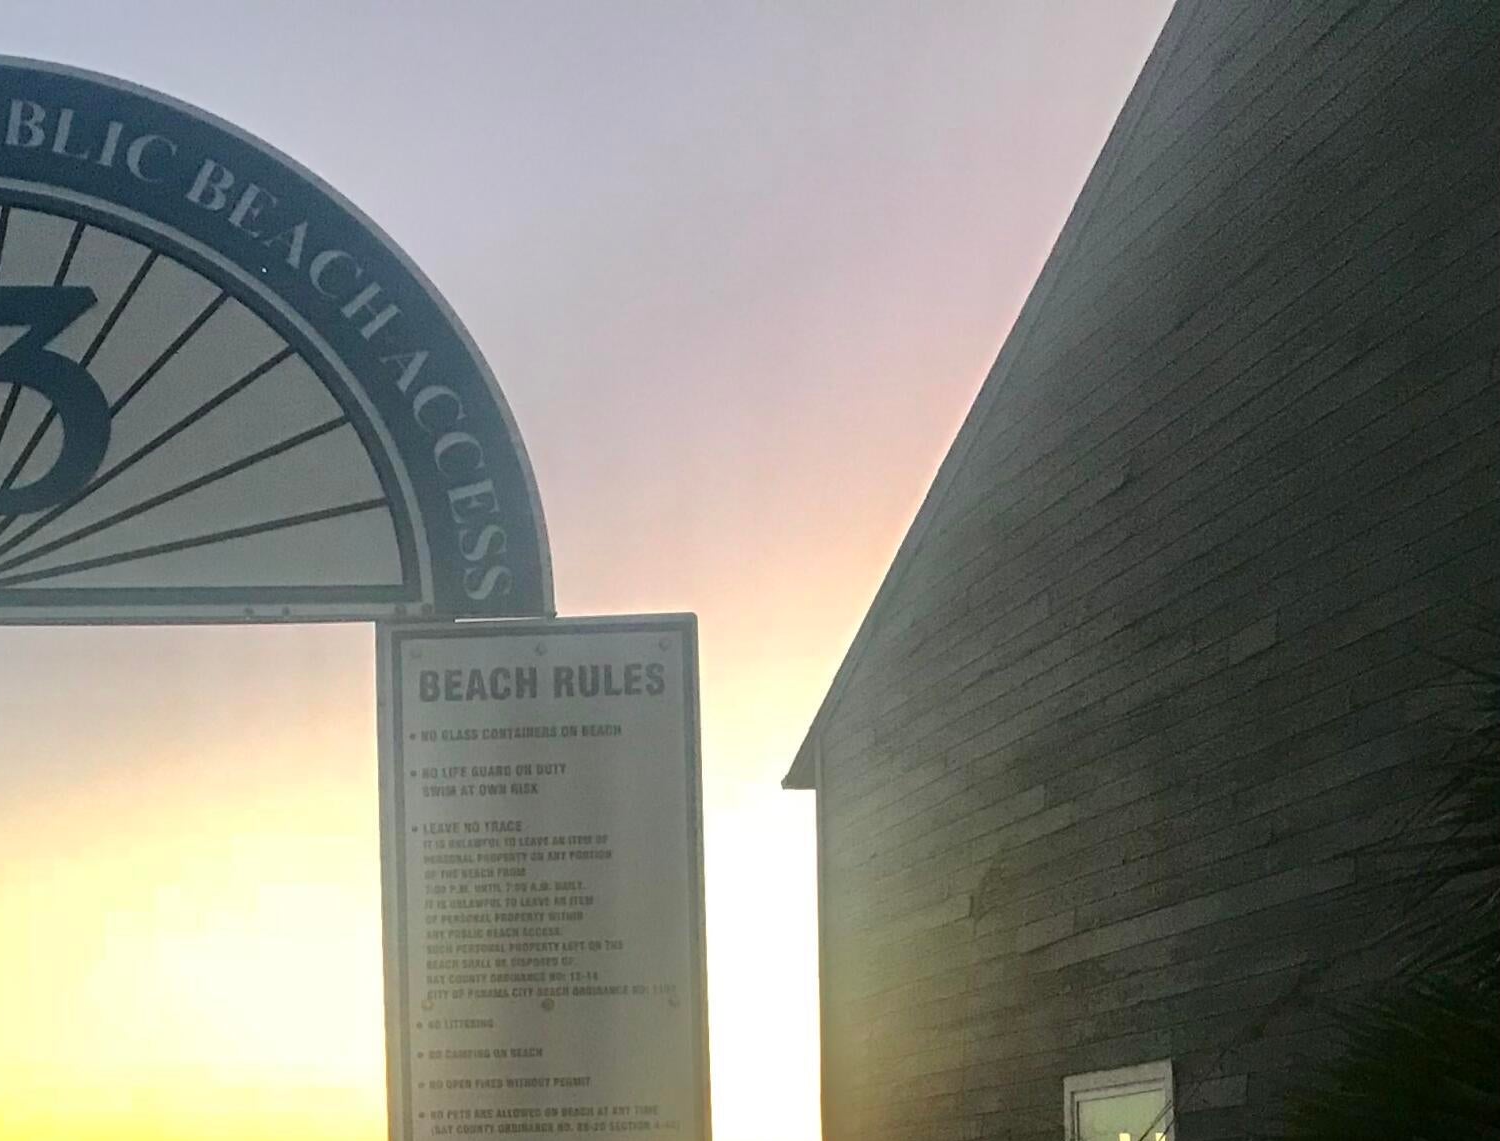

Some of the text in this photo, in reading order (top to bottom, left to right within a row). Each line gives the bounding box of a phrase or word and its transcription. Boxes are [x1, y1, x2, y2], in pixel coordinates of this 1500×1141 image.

[185, 157, 402, 342] BEACH
[380, 345, 514, 601] ACCESS
[420, 663, 665, 702] BEACH RULES
[421, 725, 621, 741] NO GLASS CONTAINERS ON BEACH
[422, 764, 566, 779] NO LIFE GUARD ON DUTY
[423, 783, 538, 797] SWIM AT OWN RISK
[423, 821, 522, 834] LEAVE NO TRACE
